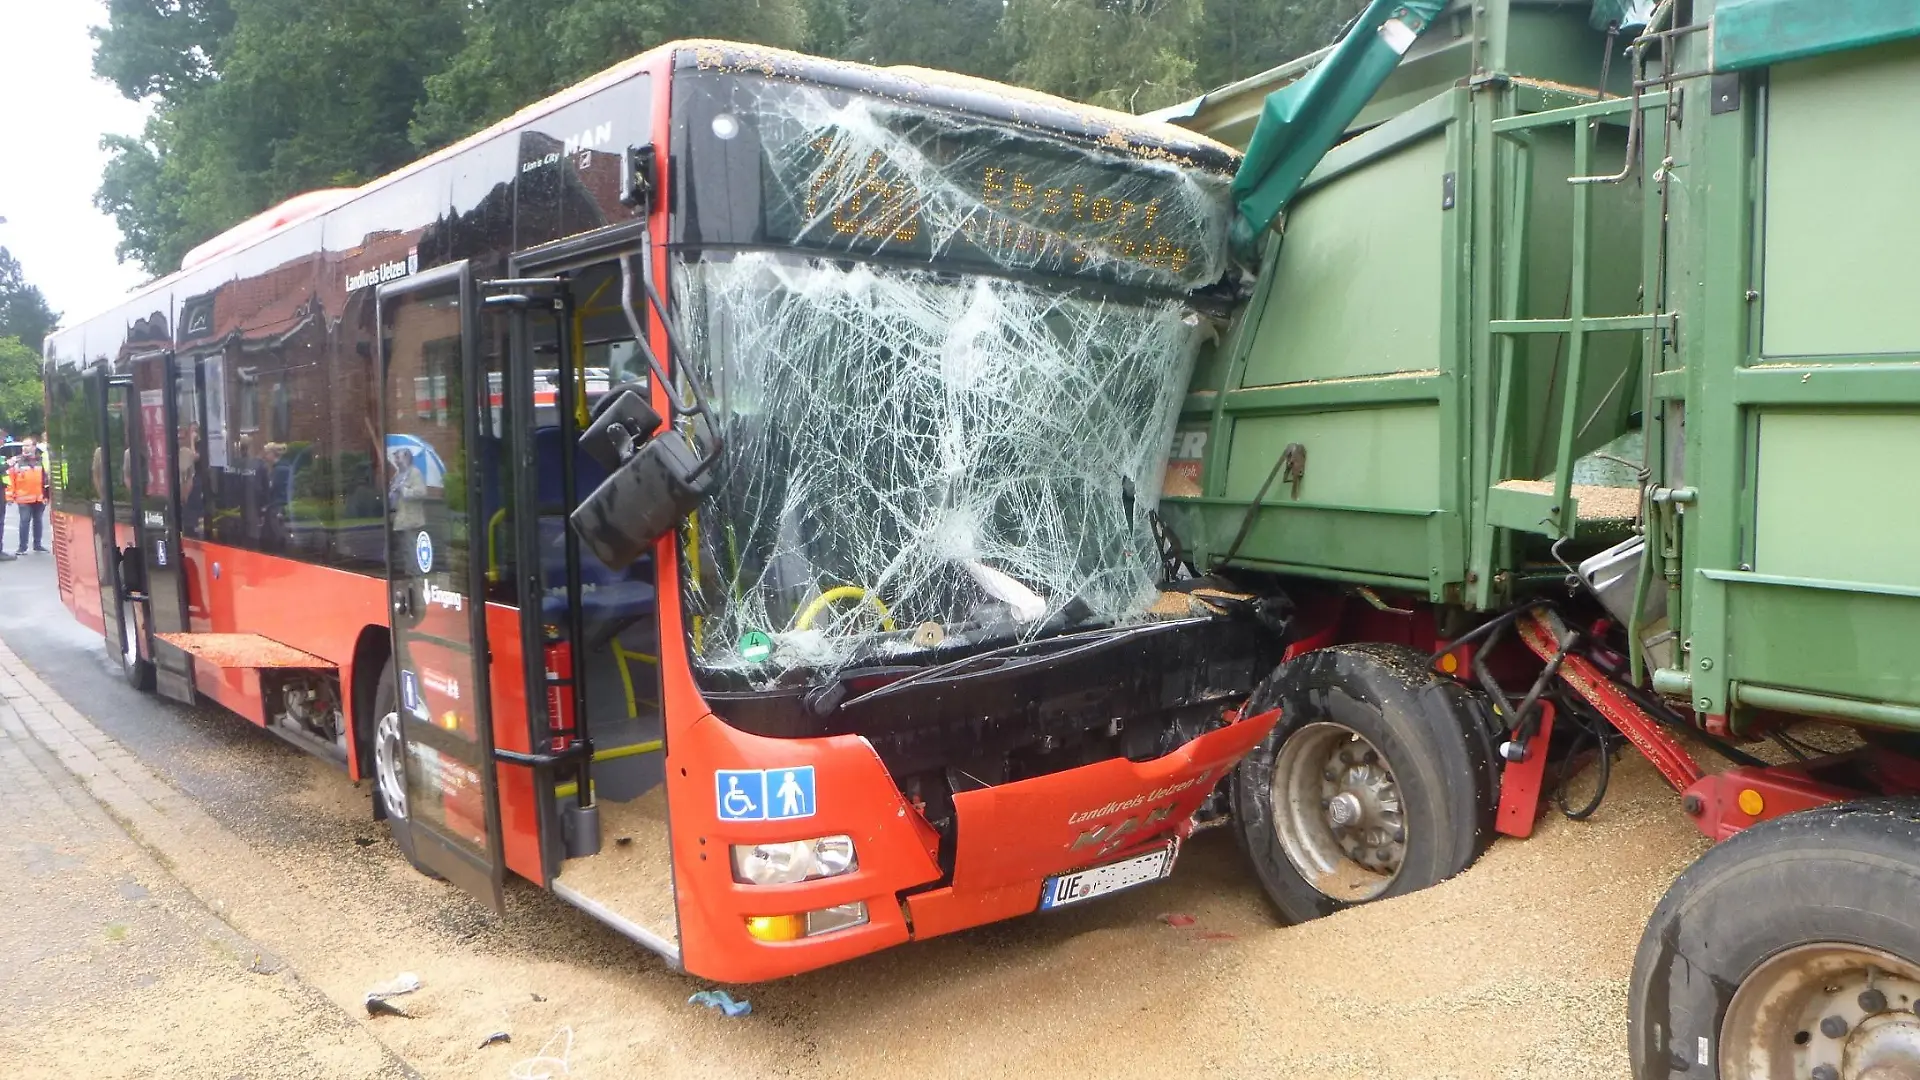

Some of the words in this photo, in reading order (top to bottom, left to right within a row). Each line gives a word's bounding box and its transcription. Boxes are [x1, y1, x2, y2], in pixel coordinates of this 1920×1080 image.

[563, 121, 612, 159] MAN
[543, 152, 560, 165] City
[984, 167, 1161, 229] Ebstorf
[345, 265, 380, 292] Landkreis
[380, 260, 406, 281] Uelzen
[750, 632, 760, 647] 4
[1068, 794, 1146, 825] Landkreis
[1147, 778, 1195, 803] Uelzen
[1057, 875, 1083, 902] UE
